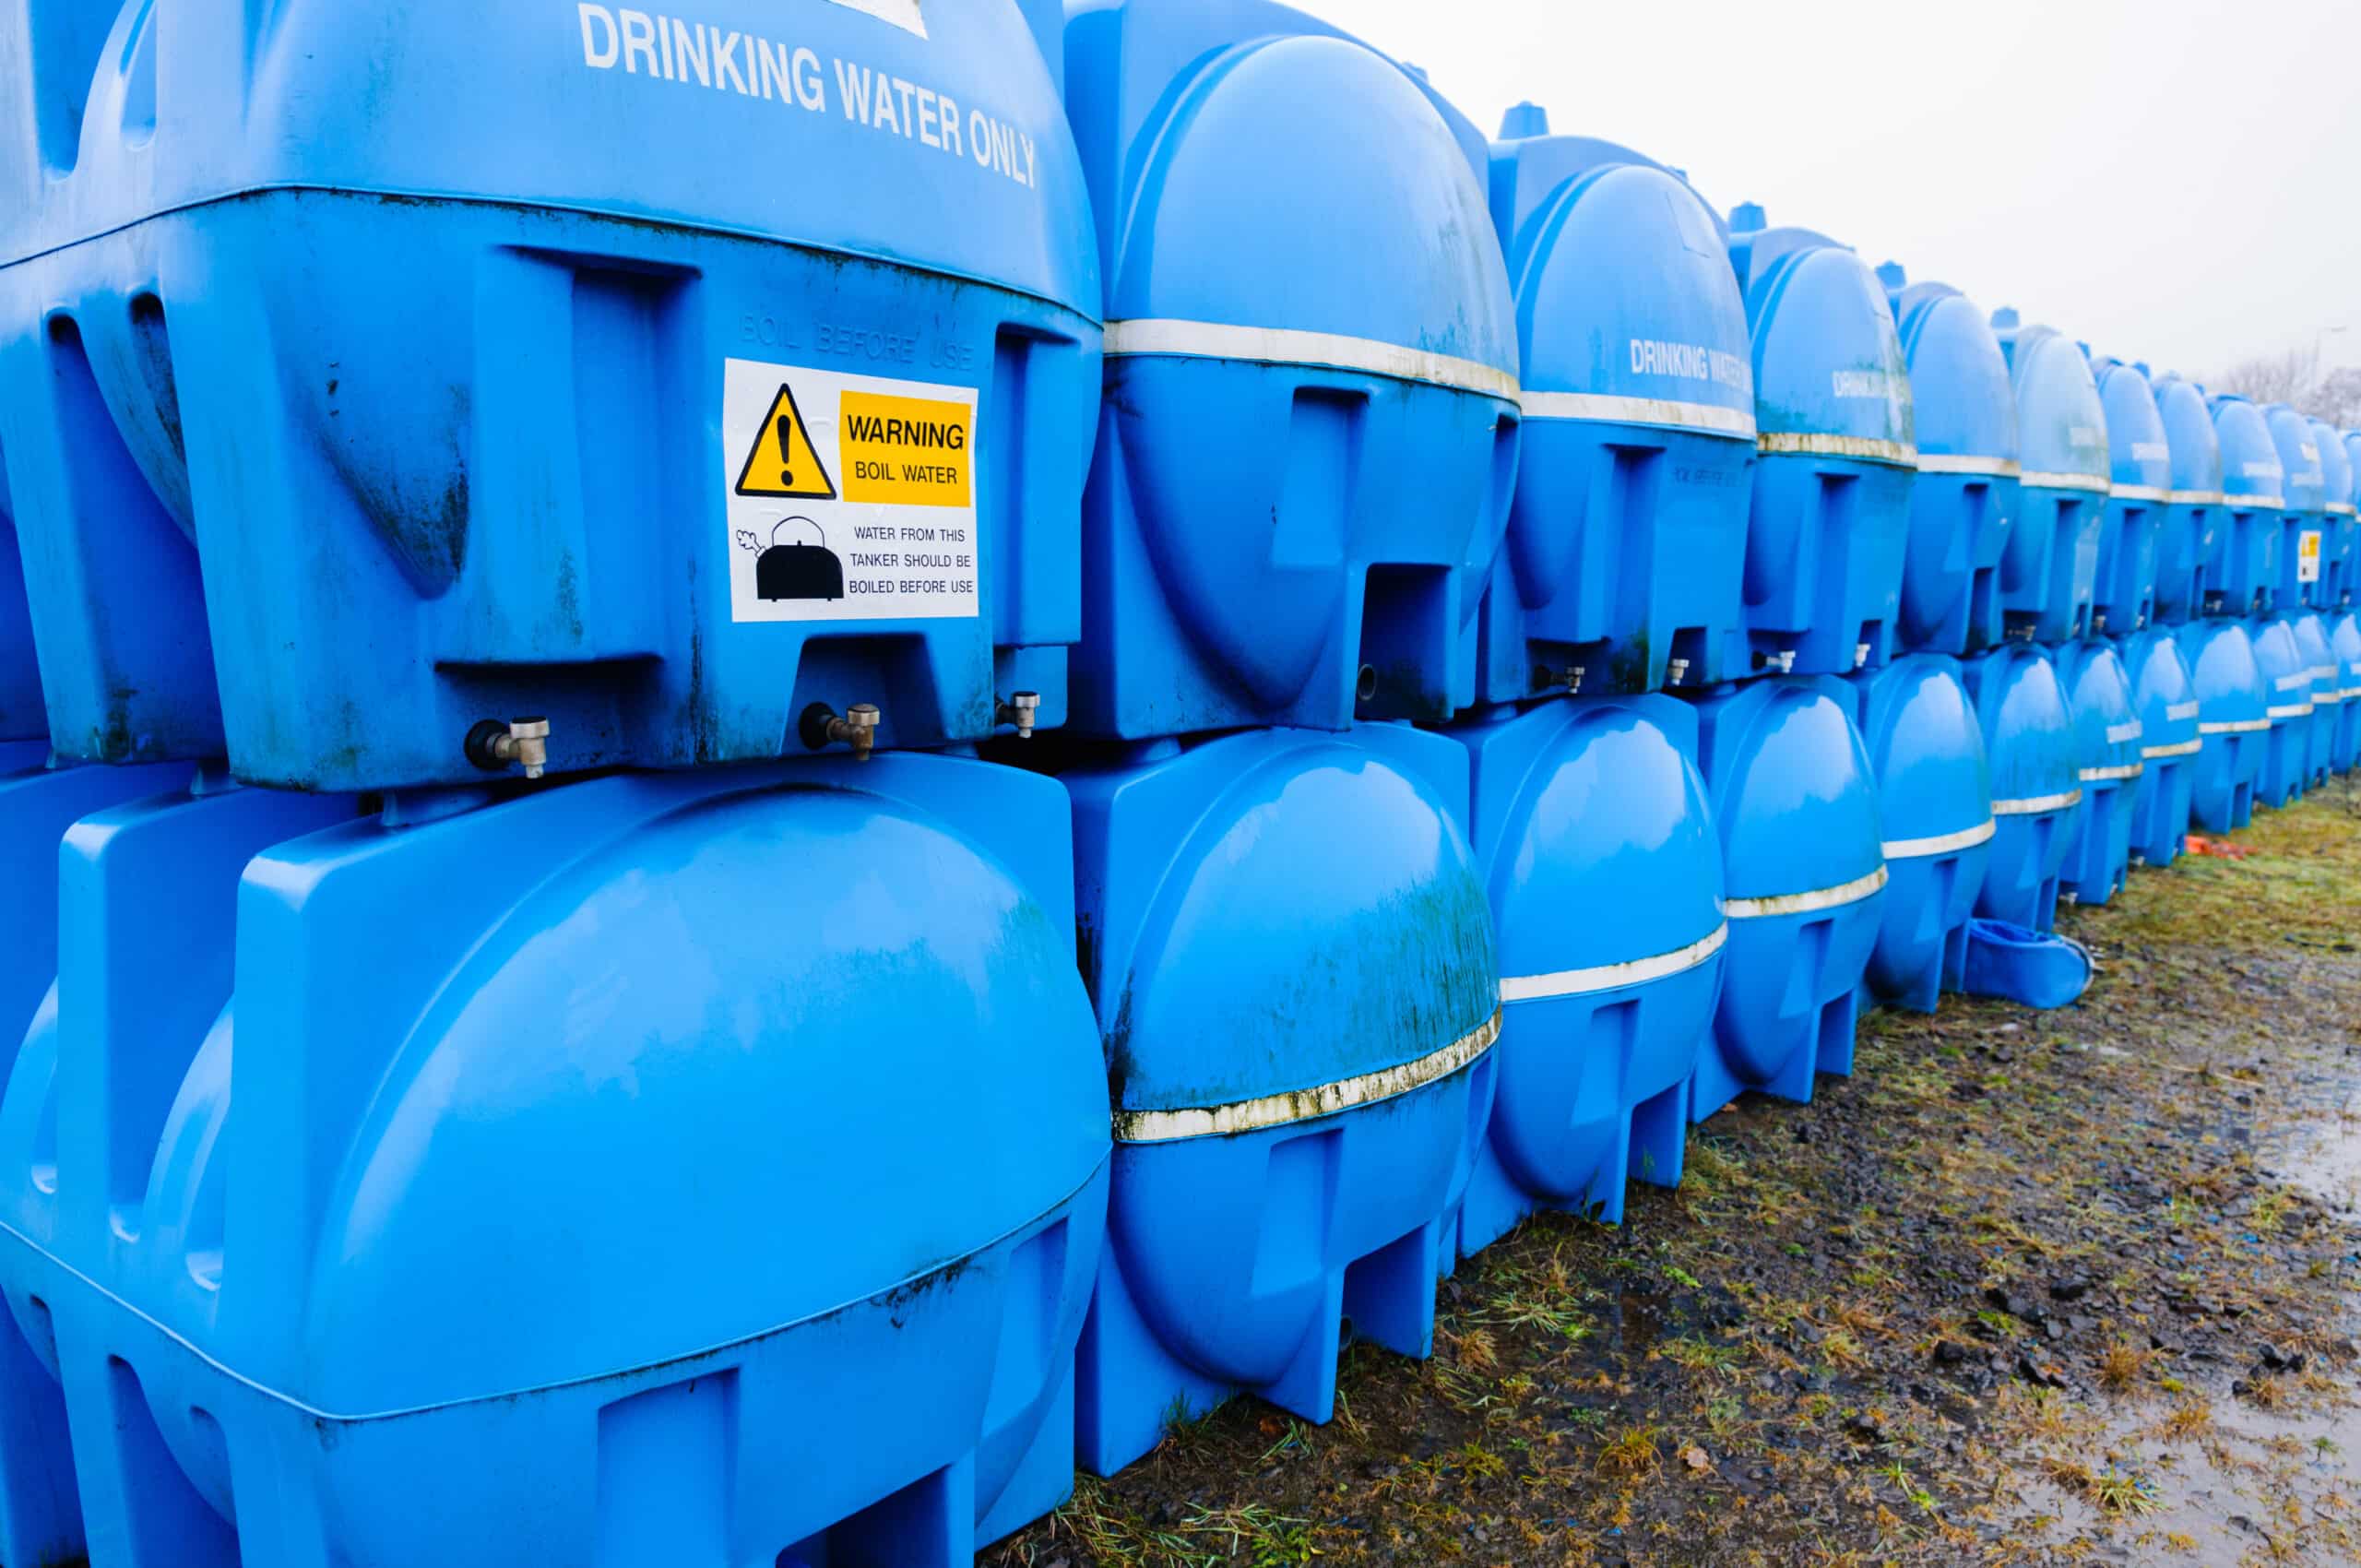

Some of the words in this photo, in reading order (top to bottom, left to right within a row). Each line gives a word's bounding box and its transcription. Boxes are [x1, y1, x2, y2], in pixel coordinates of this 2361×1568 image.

[578, 3, 826, 113] DRINKING
[834, 58, 962, 156] WATER
[970, 109, 1035, 188] ONLY
[741, 315, 801, 350] BOIL
[815, 324, 915, 363] BEFORE
[930, 337, 974, 371] USE
[1631, 339, 1708, 380] DRINKING
[848, 415, 964, 450] WARNING
[856, 461, 896, 481] BOIL
[902, 465, 957, 484] WATER
[854, 527, 896, 540] WATER
[901, 528, 935, 541] FROM
[939, 529, 965, 542] THIS
[850, 553, 899, 567] TANKER
[905, 554, 952, 567] SHOULD
[956, 555, 971, 567] BE
[849, 580, 895, 593] BOILED
[900, 580, 946, 593] BEFORE
[951, 580, 973, 593] USE
